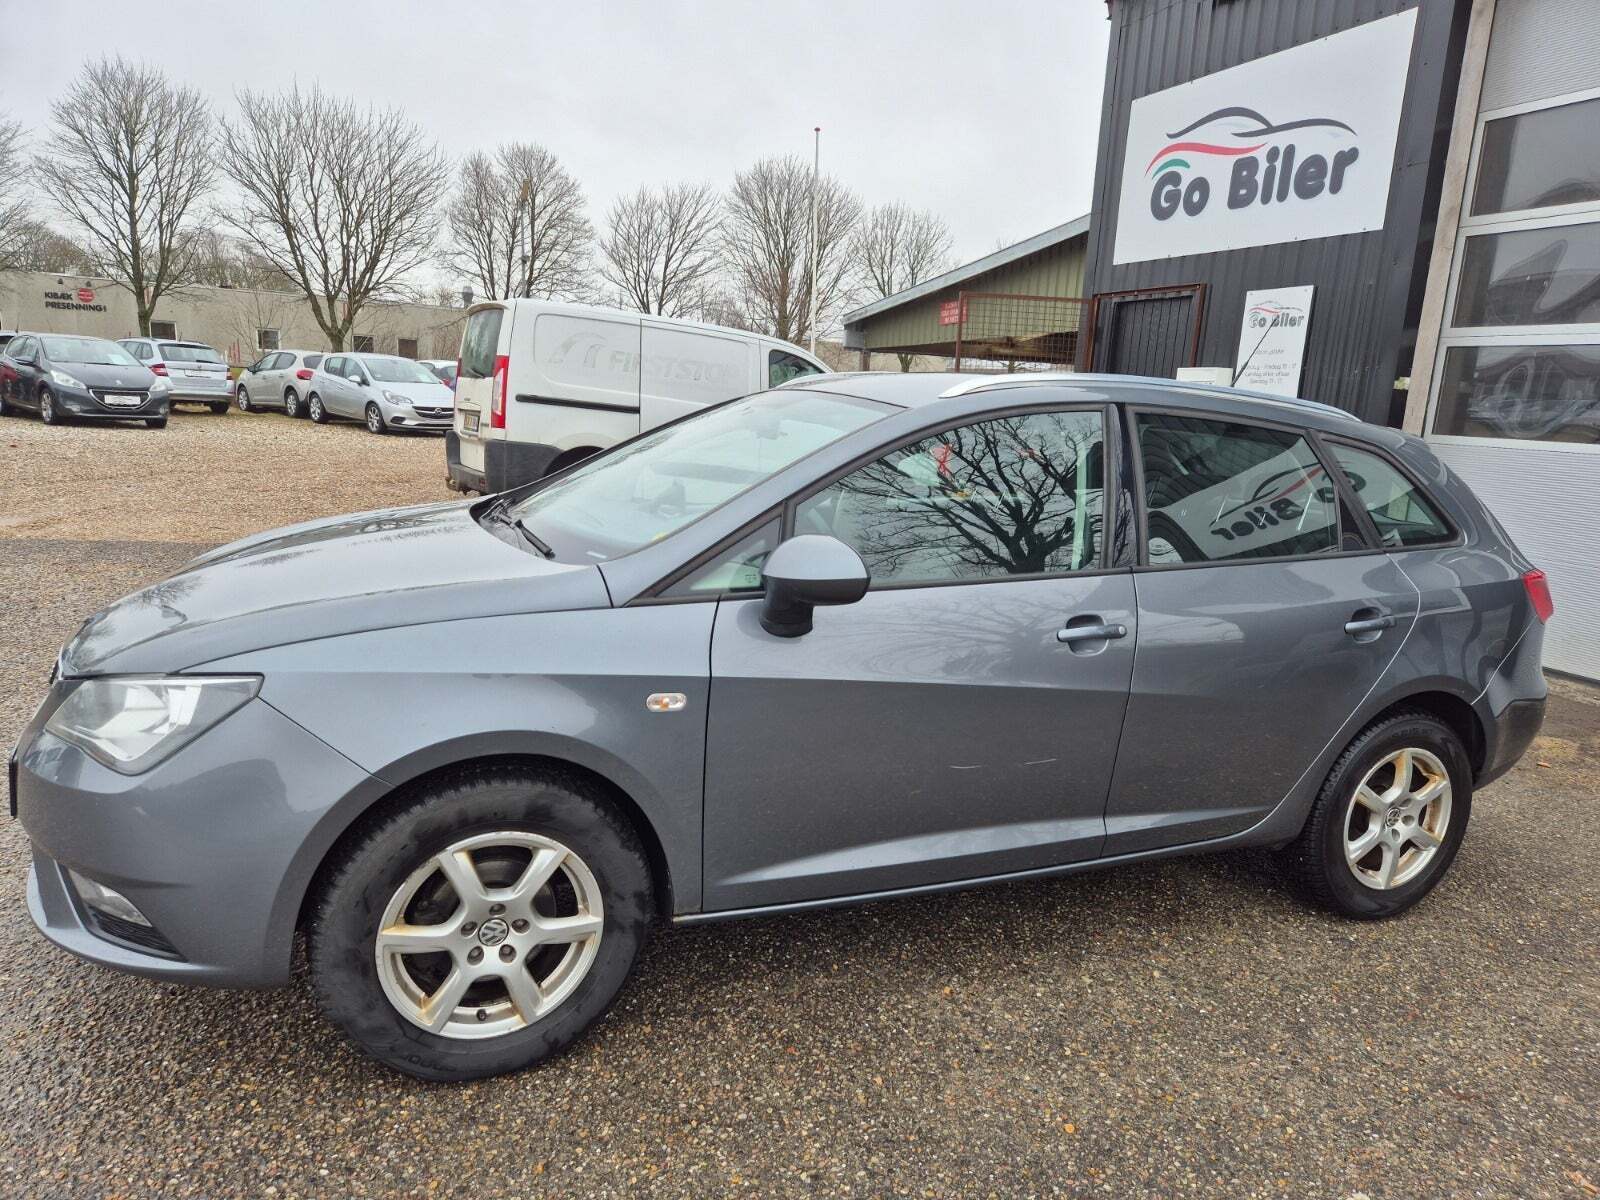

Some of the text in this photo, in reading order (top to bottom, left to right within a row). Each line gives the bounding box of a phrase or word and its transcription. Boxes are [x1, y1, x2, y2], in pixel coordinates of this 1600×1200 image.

[1150, 143, 1360, 222] Go Biler
[1249, 313, 1267, 329] Go
